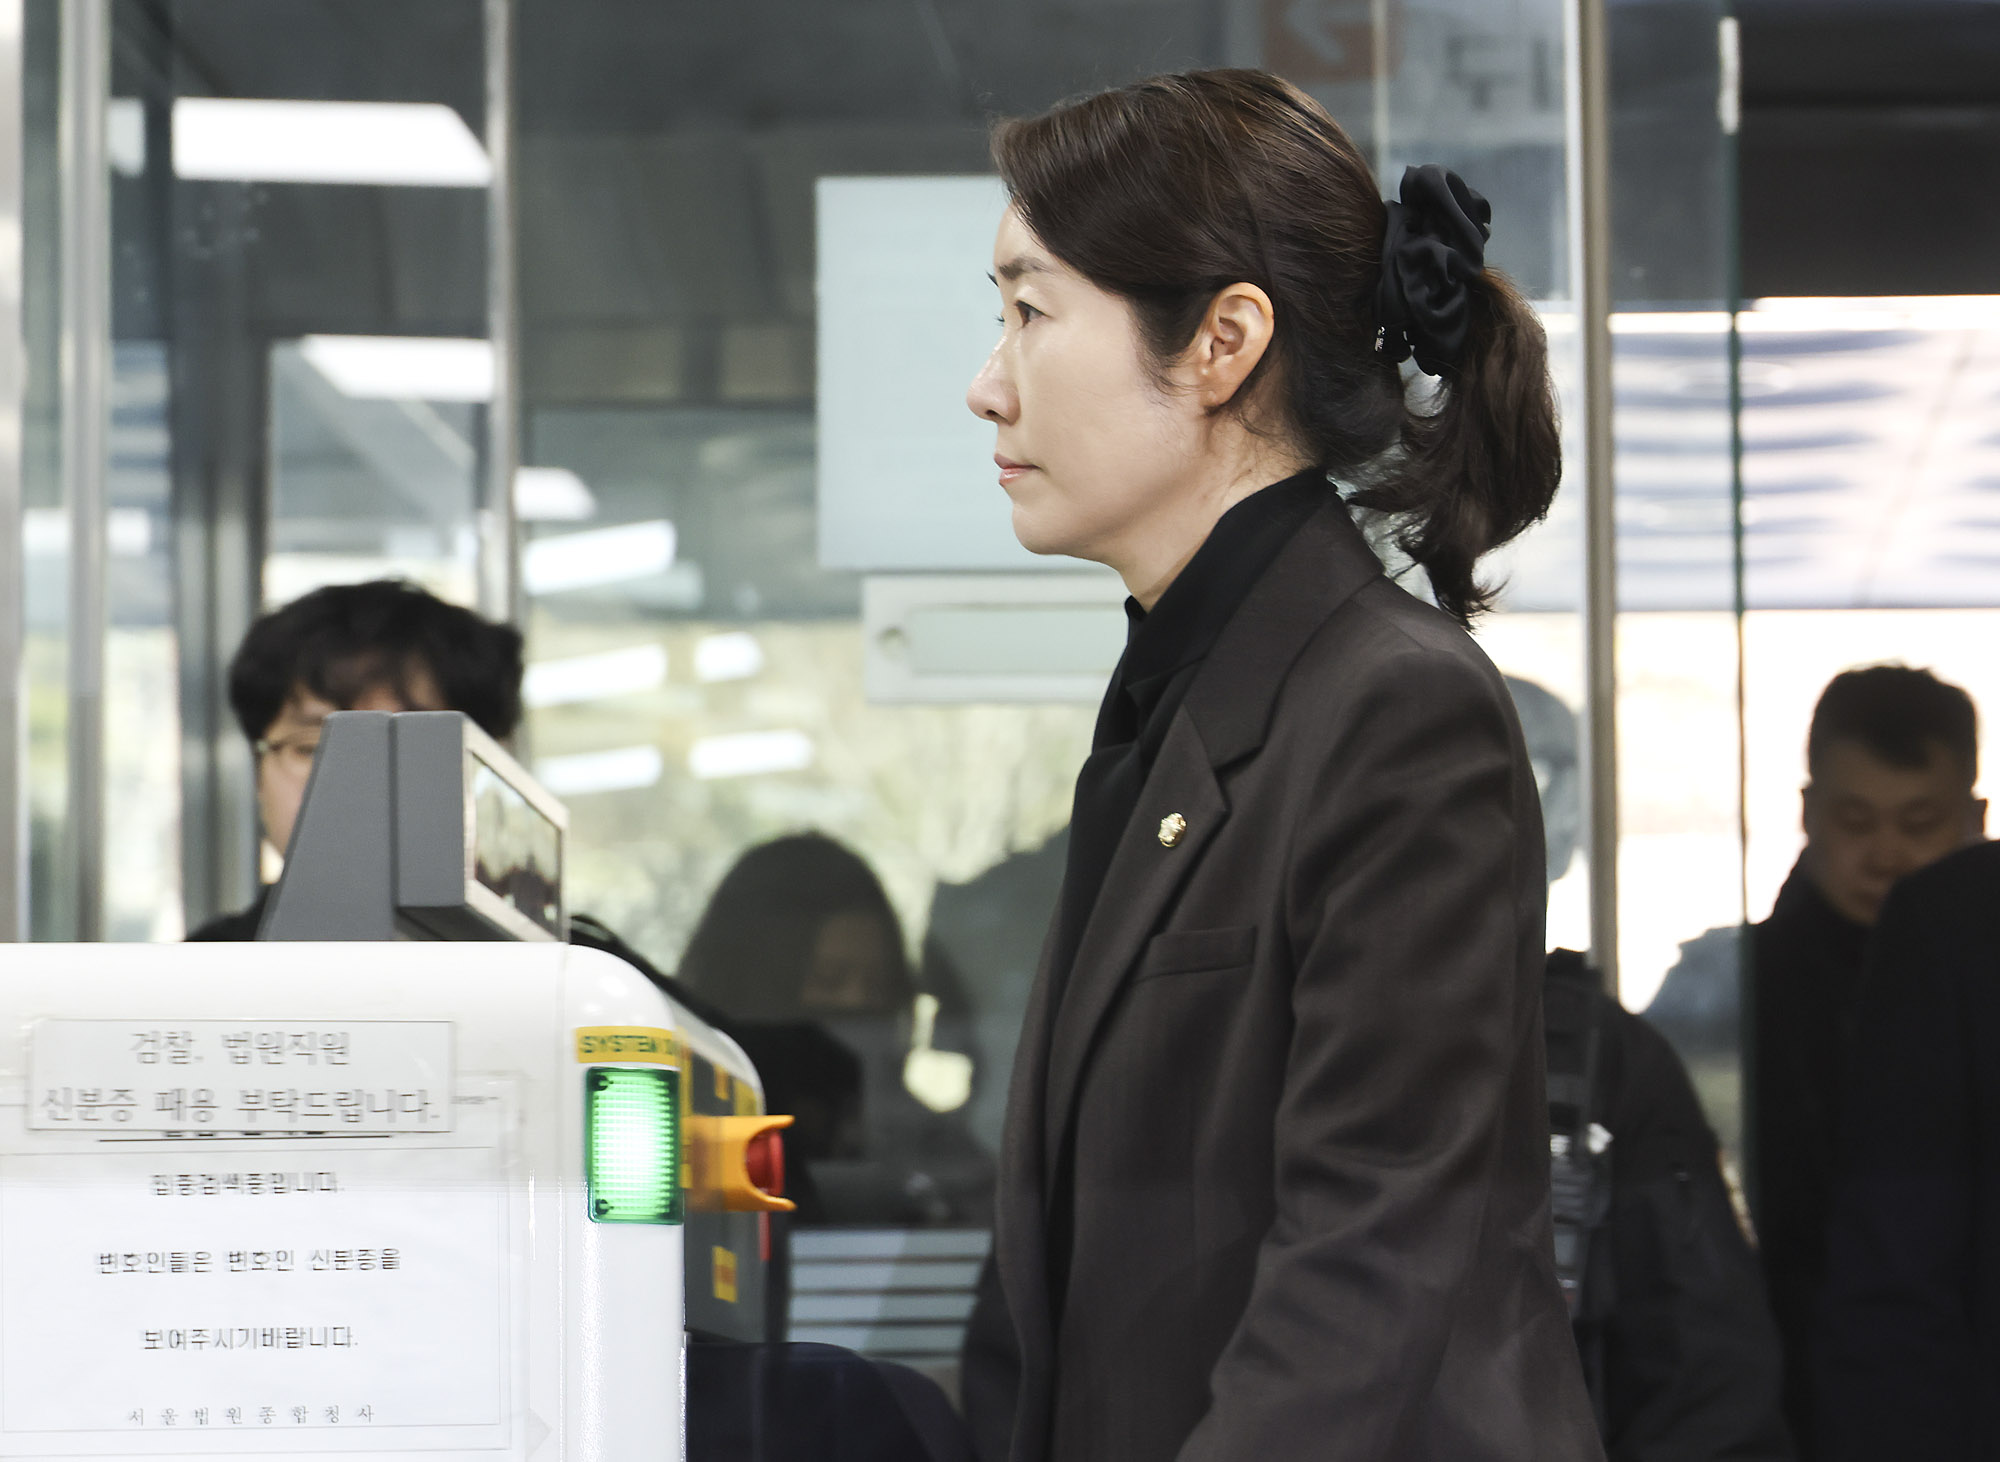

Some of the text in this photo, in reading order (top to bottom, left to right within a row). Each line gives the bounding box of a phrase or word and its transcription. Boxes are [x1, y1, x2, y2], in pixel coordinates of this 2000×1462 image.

[221, 1030, 351, 1066] 법원직원
[40, 1086, 441, 1124] 신분증 패용 부탁드립니다.
[96, 1247, 401, 1274] 변호인들은 변호인 신분증을
[142, 1326, 359, 1351] 보여주시기바랍니다.
